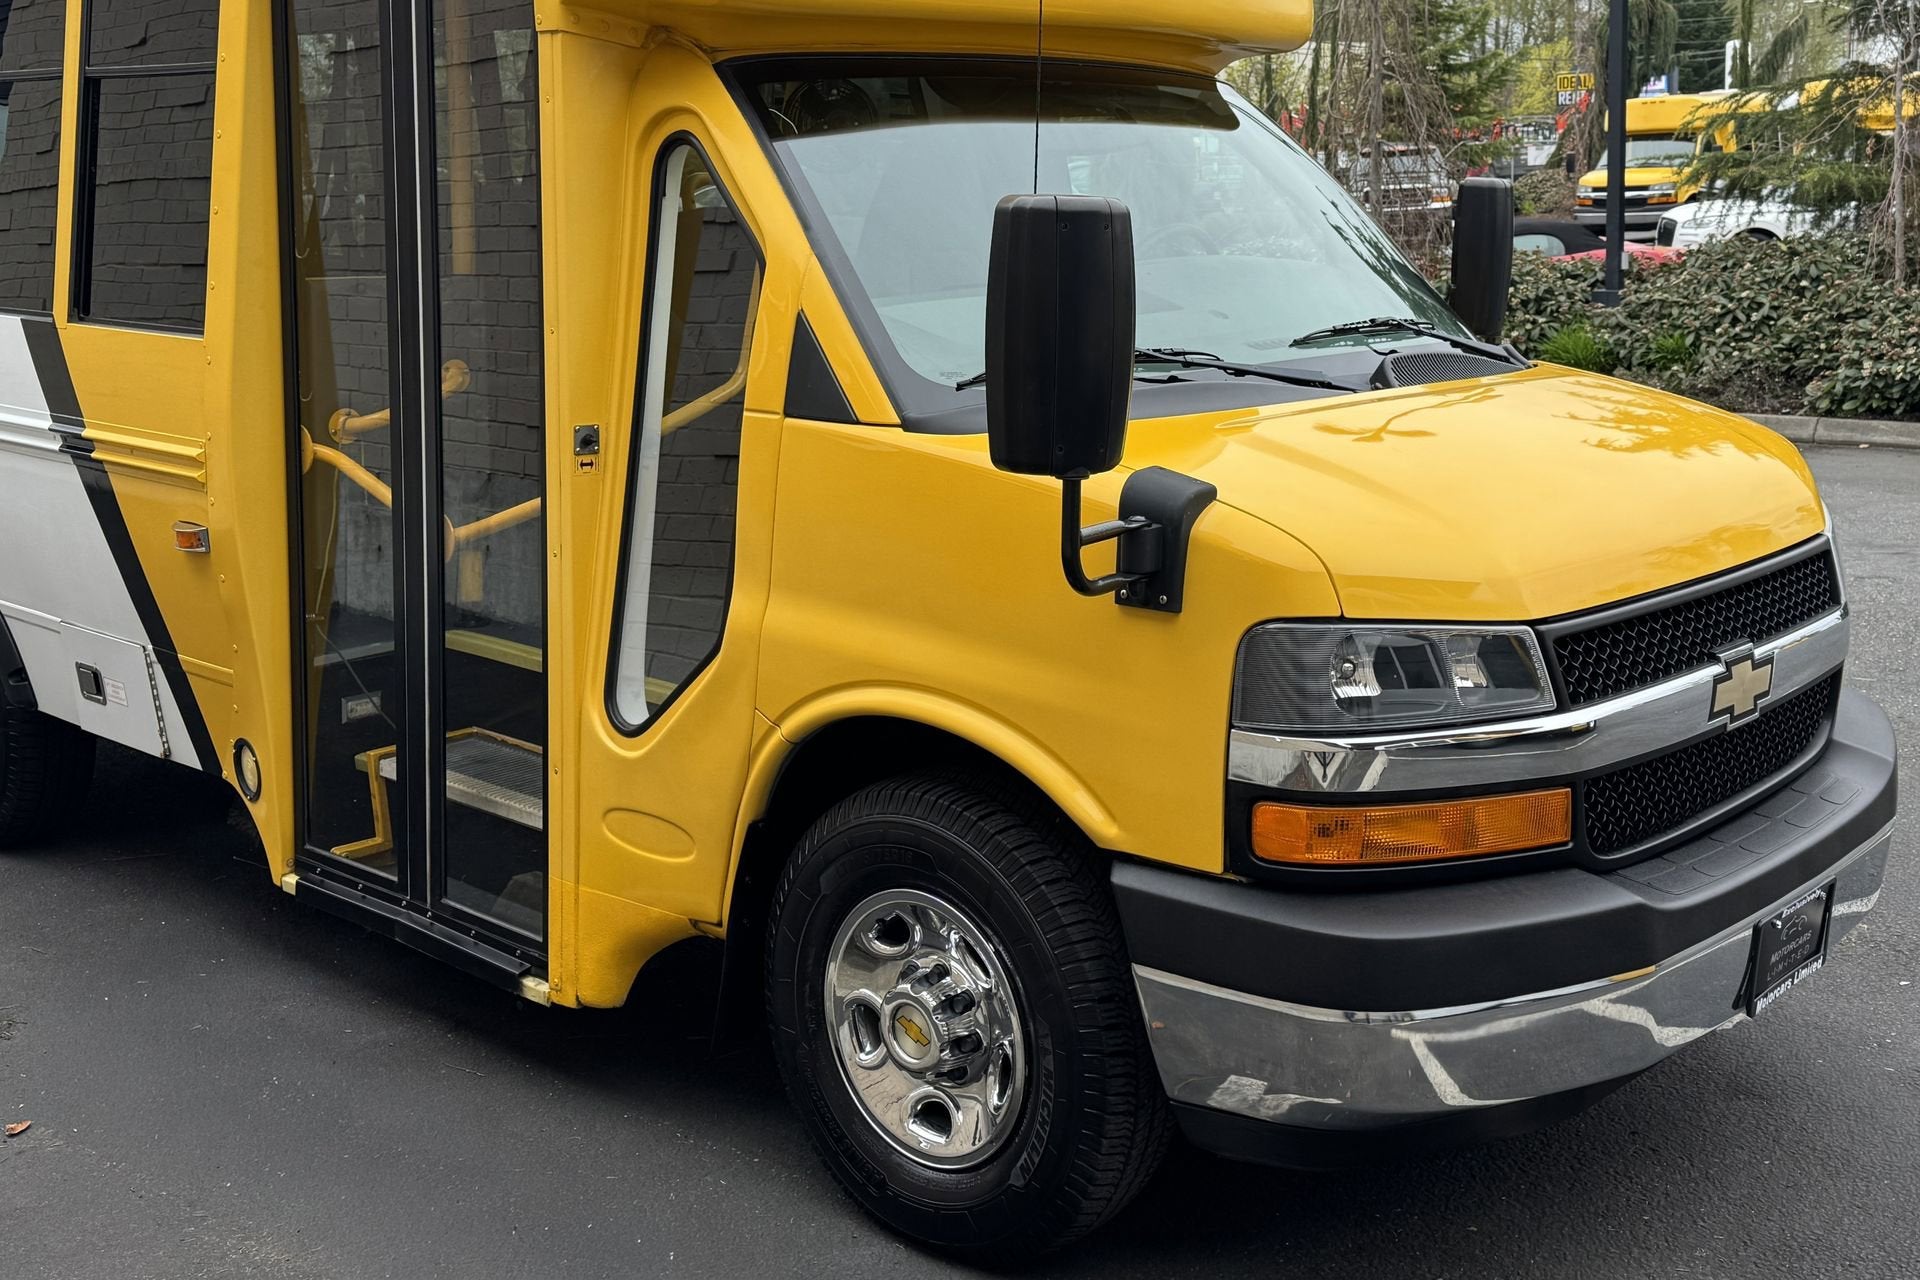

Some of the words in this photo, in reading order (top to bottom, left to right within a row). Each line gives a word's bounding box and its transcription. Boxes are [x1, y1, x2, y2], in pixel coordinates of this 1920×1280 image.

[1559, 76, 1588, 89] IDEAL
[1769, 930, 1812, 966] MOTORCARS
[1755, 978, 1792, 1015] Motorcars
[1794, 956, 1823, 985] Limited
[1020, 1064, 1054, 1180] MICHELIN
